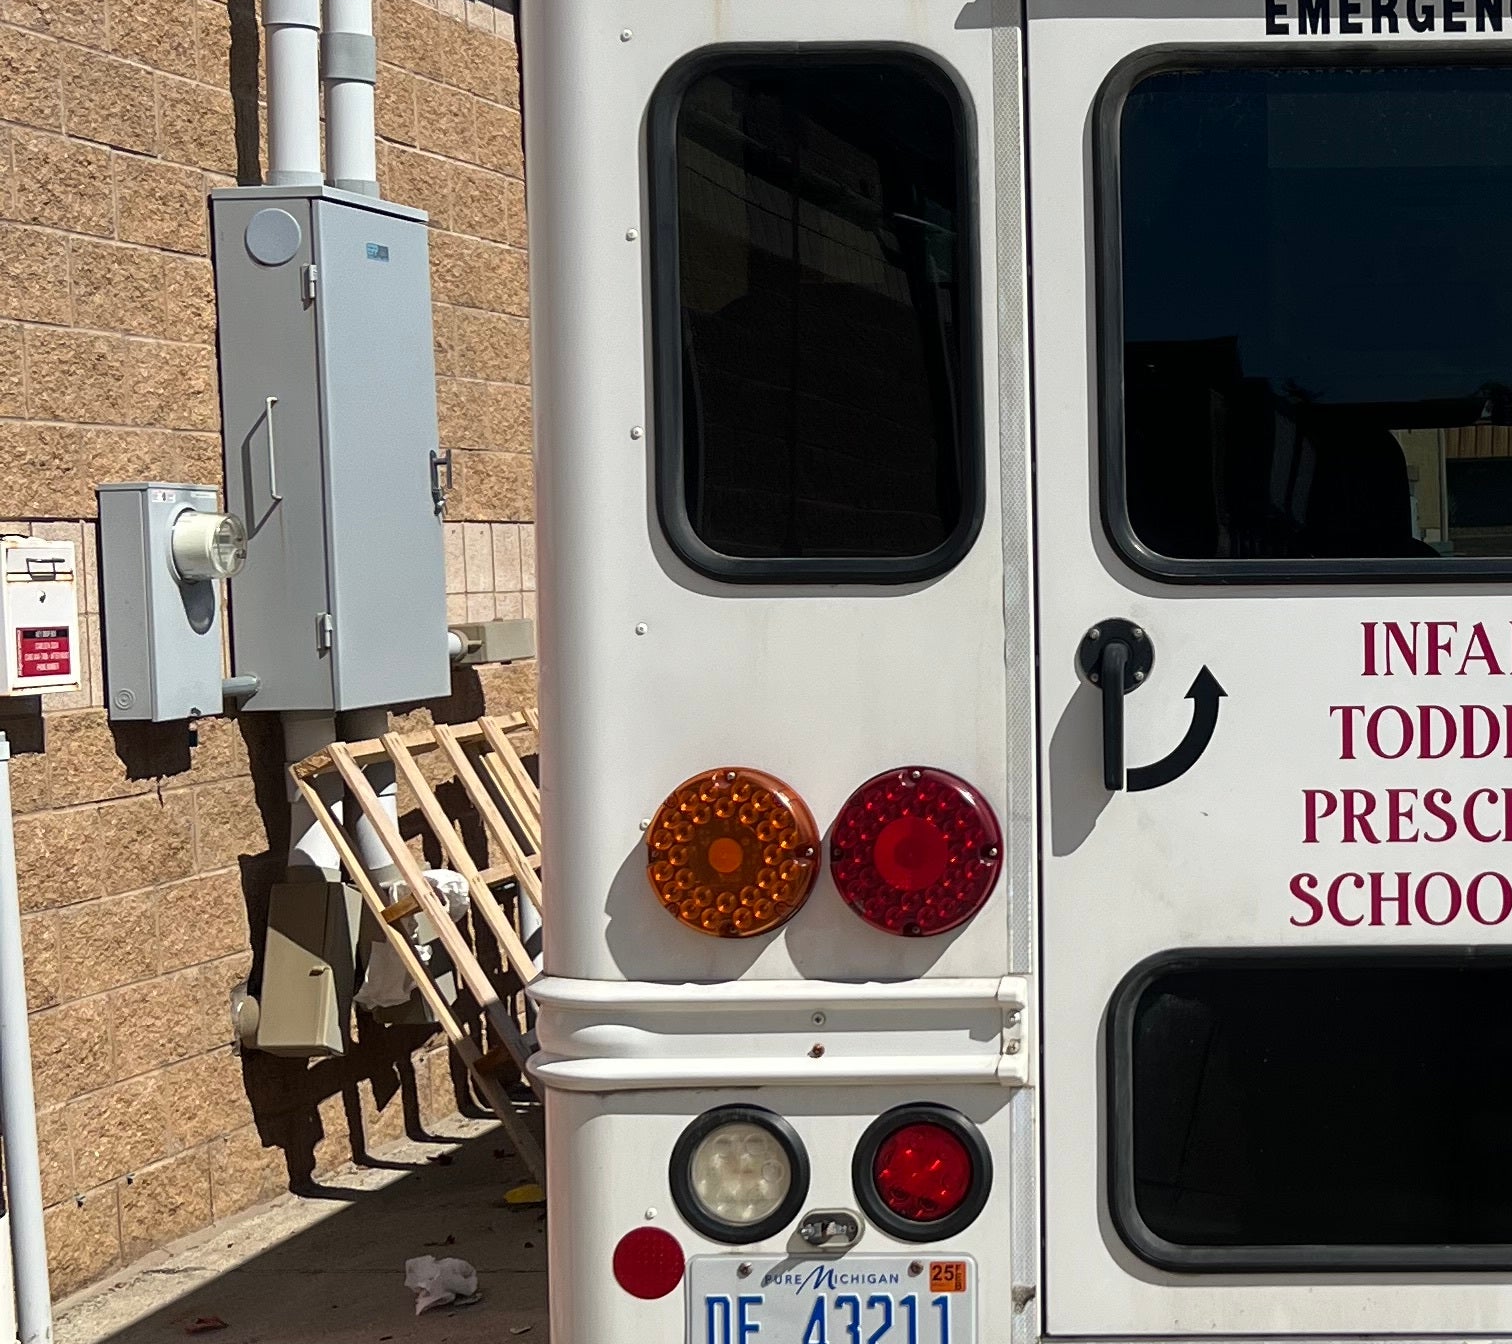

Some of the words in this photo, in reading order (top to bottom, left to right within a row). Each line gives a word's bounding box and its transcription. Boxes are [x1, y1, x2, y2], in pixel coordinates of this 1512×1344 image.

[765, 1274, 802, 1285] PURE
[796, 1265, 899, 1295] MICHIGAN
[931, 1264, 954, 1281] 25
